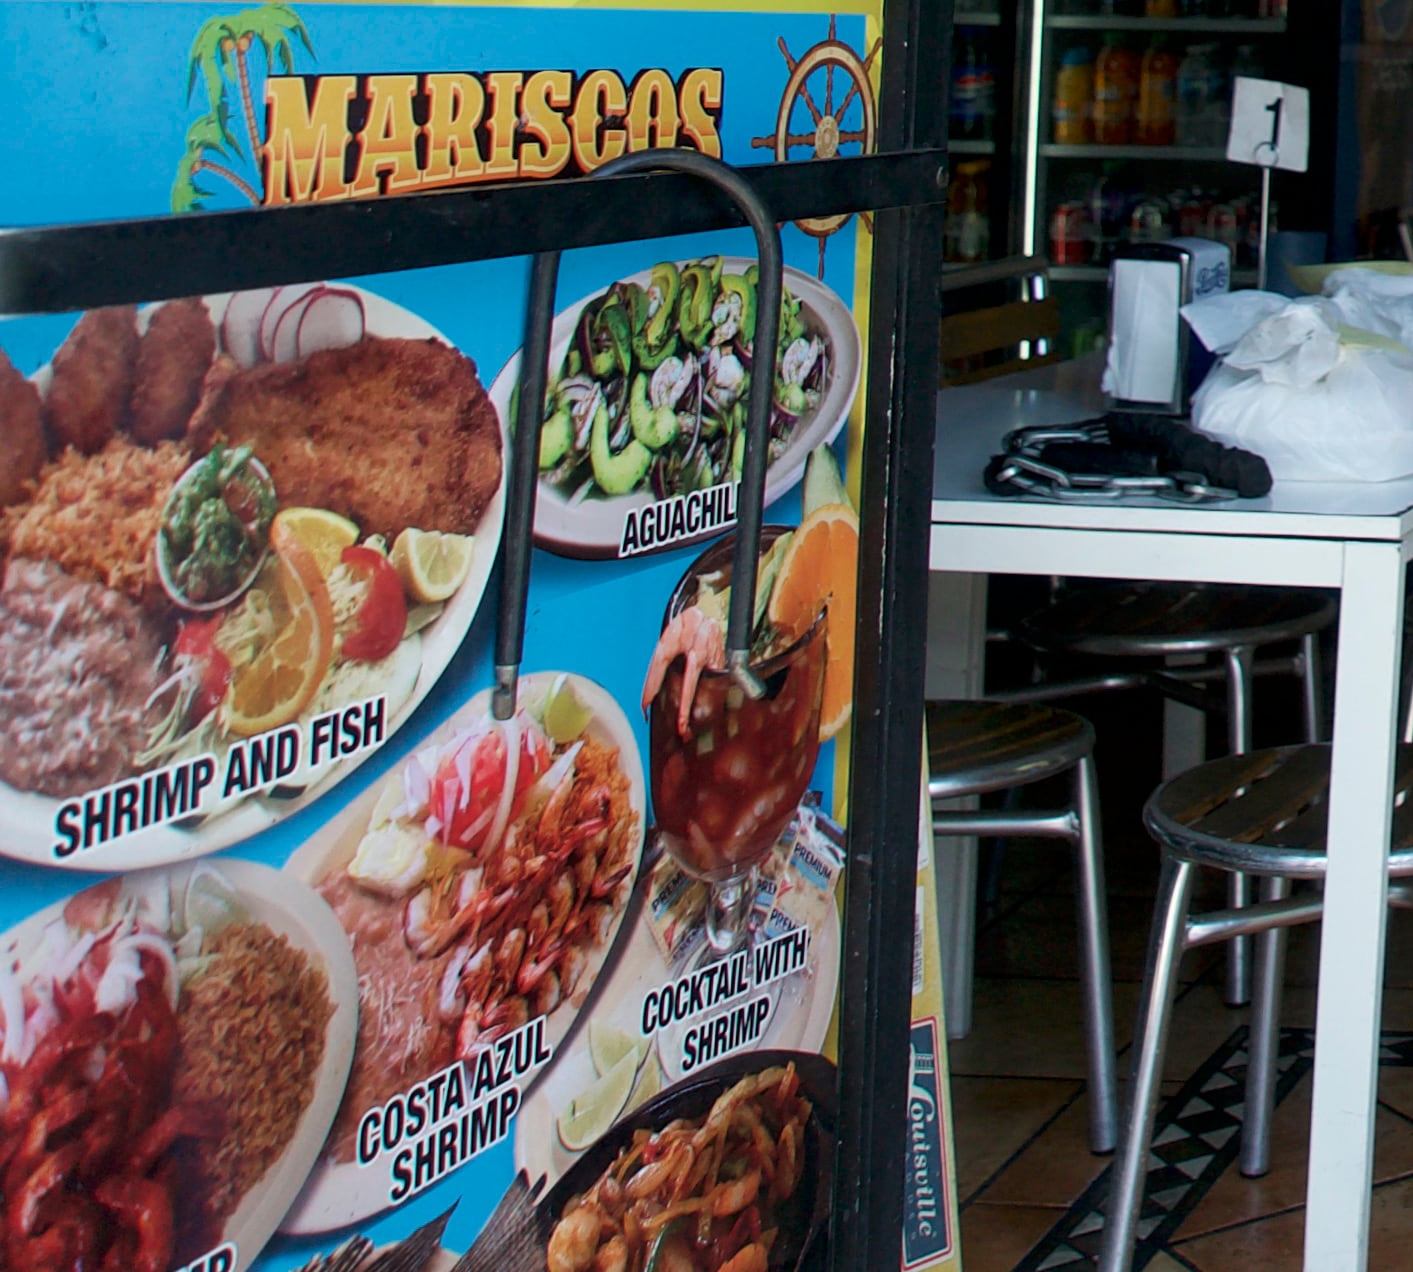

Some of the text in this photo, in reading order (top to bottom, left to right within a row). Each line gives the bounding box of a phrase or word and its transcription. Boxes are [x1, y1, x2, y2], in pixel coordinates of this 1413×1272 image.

[262, 69, 724, 206] MARISCOS
[1266, 97, 1283, 150] 1
[55, 698, 386, 859] SHRIMP AND FISH
[796, 841, 833, 880] PREMIUM
[643, 928, 806, 1035] COCKTAIL WITH
[683, 1001, 771, 1070] SHRIMP
[359, 1019, 552, 1164] COSTA AZUL
[391, 1090, 520, 1199] SHRIMP
[908, 1053, 937, 1237] Louisville
